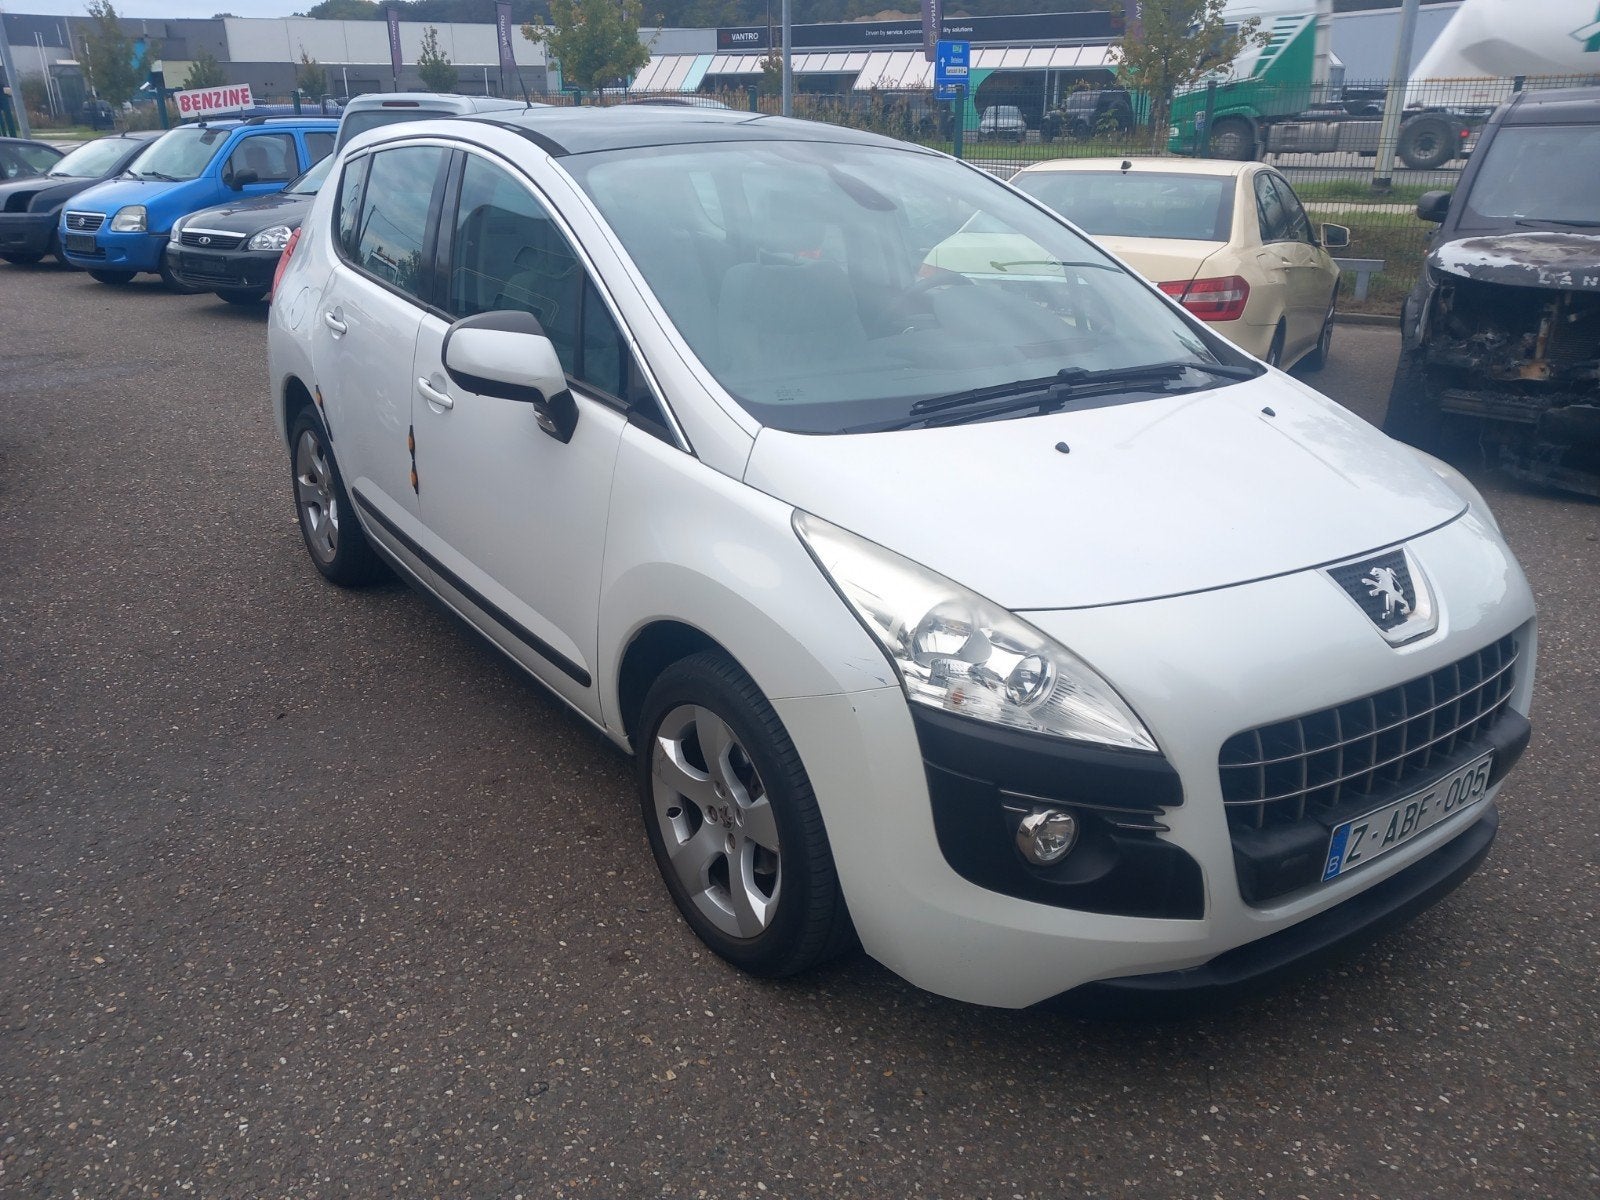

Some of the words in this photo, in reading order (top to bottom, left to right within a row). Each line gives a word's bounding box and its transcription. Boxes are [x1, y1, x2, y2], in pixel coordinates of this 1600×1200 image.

[500, 14, 508, 47] VANTRO
[731, 32, 759, 41] VANTRO
[180, 88, 250, 112] BENZINE
[1327, 856, 1340, 873] B
